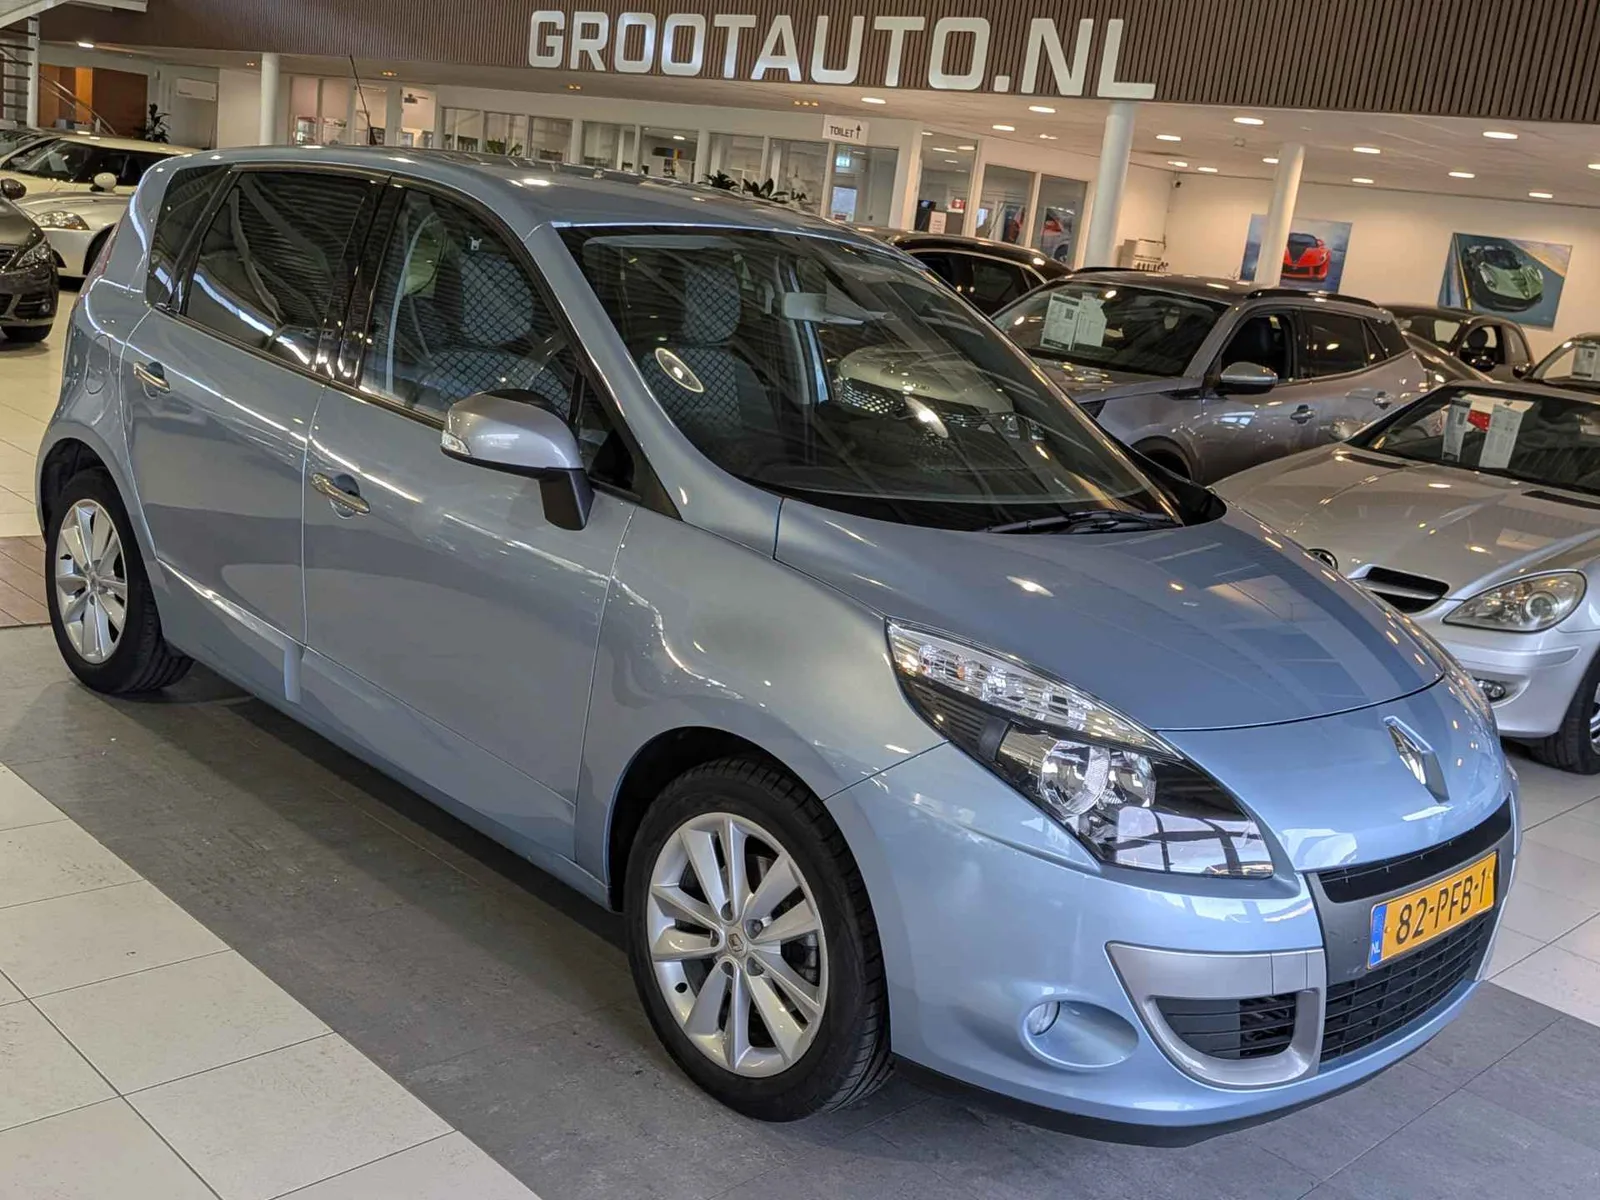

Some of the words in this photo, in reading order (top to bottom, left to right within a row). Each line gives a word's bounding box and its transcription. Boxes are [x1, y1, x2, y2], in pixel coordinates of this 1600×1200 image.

[528, 9, 1156, 99] GROOTAUTO.NL
[830, 126, 854, 138] TOILET
[1395, 867, 1487, 945] 82-PFB-1
[1371, 941, 1380, 955] NL
